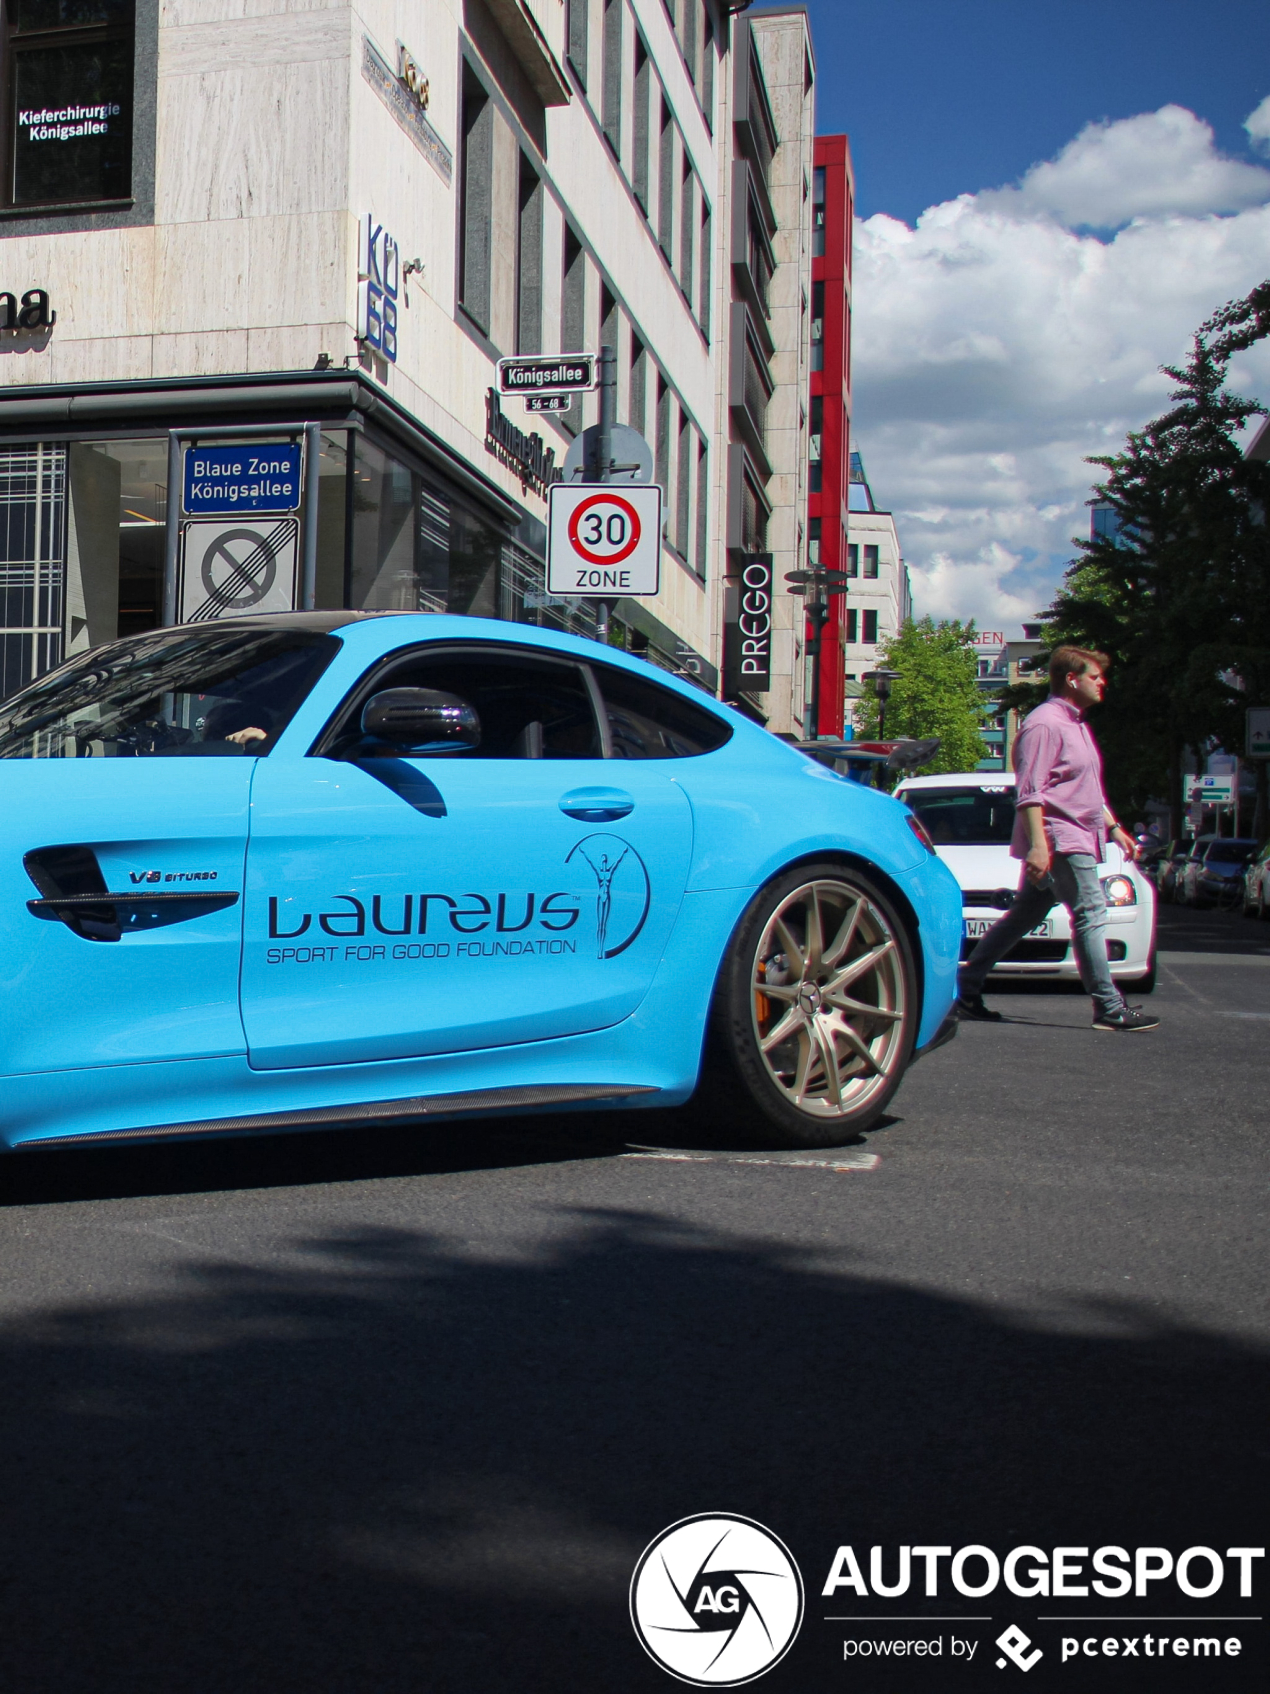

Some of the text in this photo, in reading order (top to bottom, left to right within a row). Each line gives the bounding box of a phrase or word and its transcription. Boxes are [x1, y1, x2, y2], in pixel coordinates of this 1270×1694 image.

[19, 102, 120, 126] Kieferchirurgie
[29, 121, 108, 141] Königsallee
[508, 365, 583, 386] Königsallee
[194, 458, 291, 478] Blaue Zone
[191, 478, 292, 501] Königsallee
[583, 513, 626, 546] 30
[576, 570, 630, 588] ZONE
[739, 564, 770, 674] PREGO
[129, 870, 218, 883] V8 BITURBO
[266, 939, 577, 964] SPORT FOR GOOD FOUNDATION
